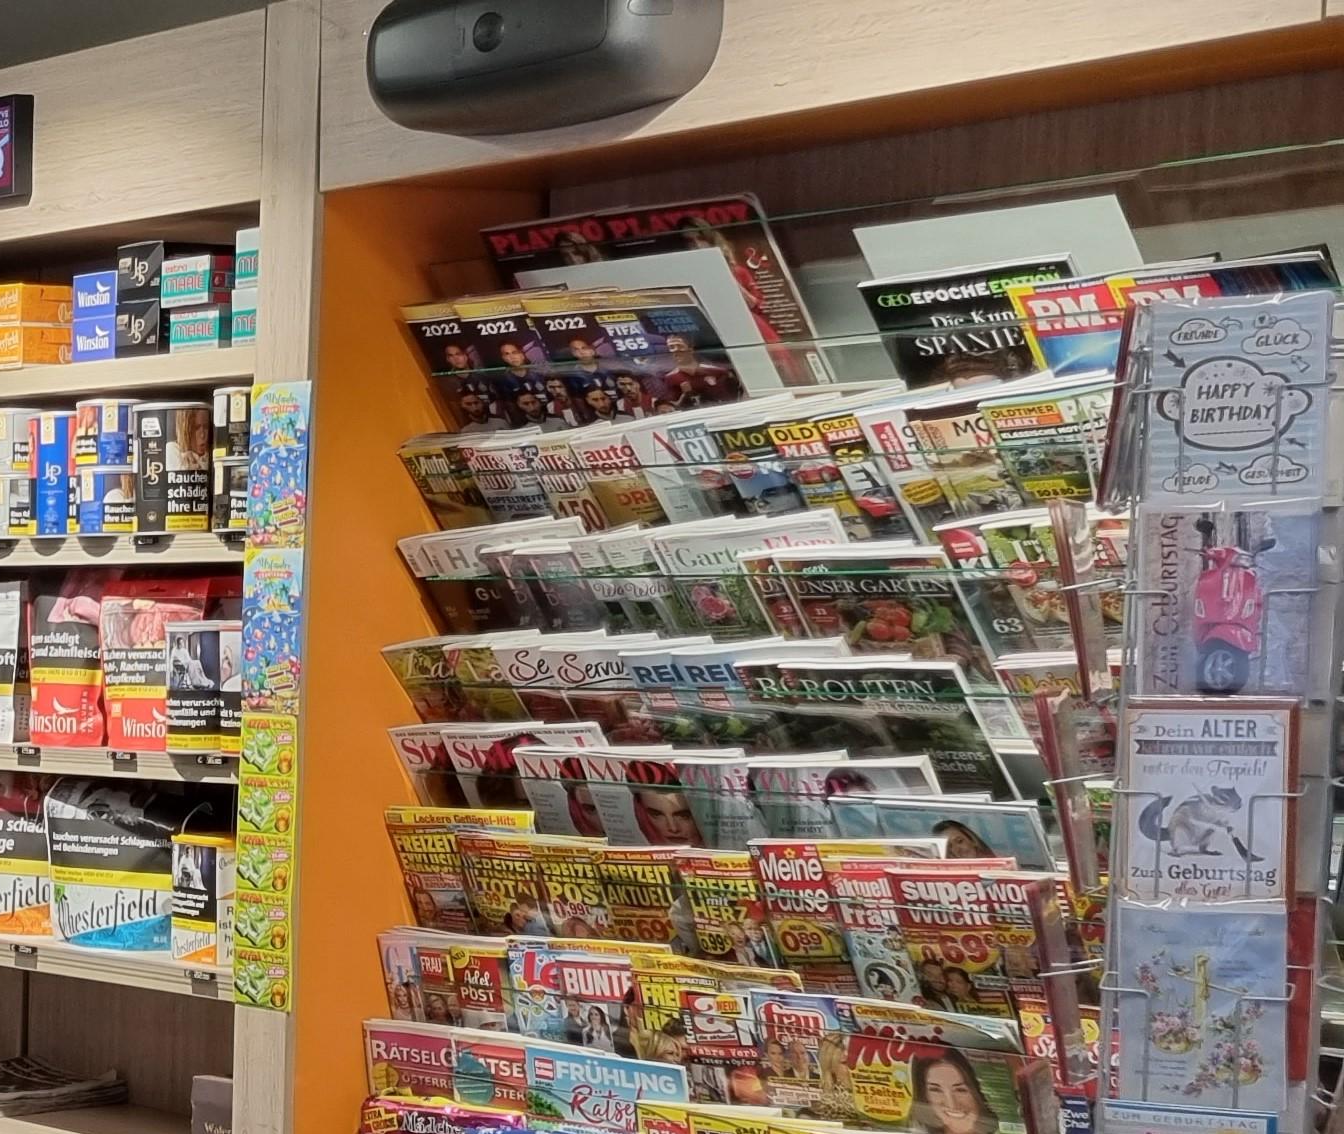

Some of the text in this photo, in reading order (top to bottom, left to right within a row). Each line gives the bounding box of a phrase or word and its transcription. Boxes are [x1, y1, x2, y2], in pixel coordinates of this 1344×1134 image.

[77, 290, 111, 305] Winston
[422, 321, 462, 339] 2022
[477, 316, 586, 335] 2022 2022
[606, 323, 641, 337] FIFA
[76, 333, 109, 351] Winston
[613, 337, 650, 351] 365
[1177, 329, 1219, 341] FREUNDE
[1256, 333, 1300, 347] GLÜCK
[1197, 382, 1256, 400] HAPPY
[990, 403, 1058, 419] OLDTIMER
[1190, 403, 1276, 423] BIRTHDAY
[584, 444, 633, 462] auto
[167, 501, 190, 512] Ihre
[796, 576, 950, 596] UNSER GARTEN
[993, 618, 1023, 634] 63
[44, 634, 80, 646] schädigt
[1154, 719, 1257, 738] Dein ALTER
[413, 813, 516, 827] Lockere Geflügel-Hits
[62, 843, 119, 856] Behinderungen
[394, 834, 458, 854] FREIZEIT
[599, 864, 671, 884] FREIZEIT
[759, 852, 823, 882] Meine
[1167, 864, 1277, 887] Geburtstag
[58, 889, 158, 941] Chesterfield
[420, 955, 442, 974] FRAU
[553, 1061, 677, 1095] FRÜHLING
